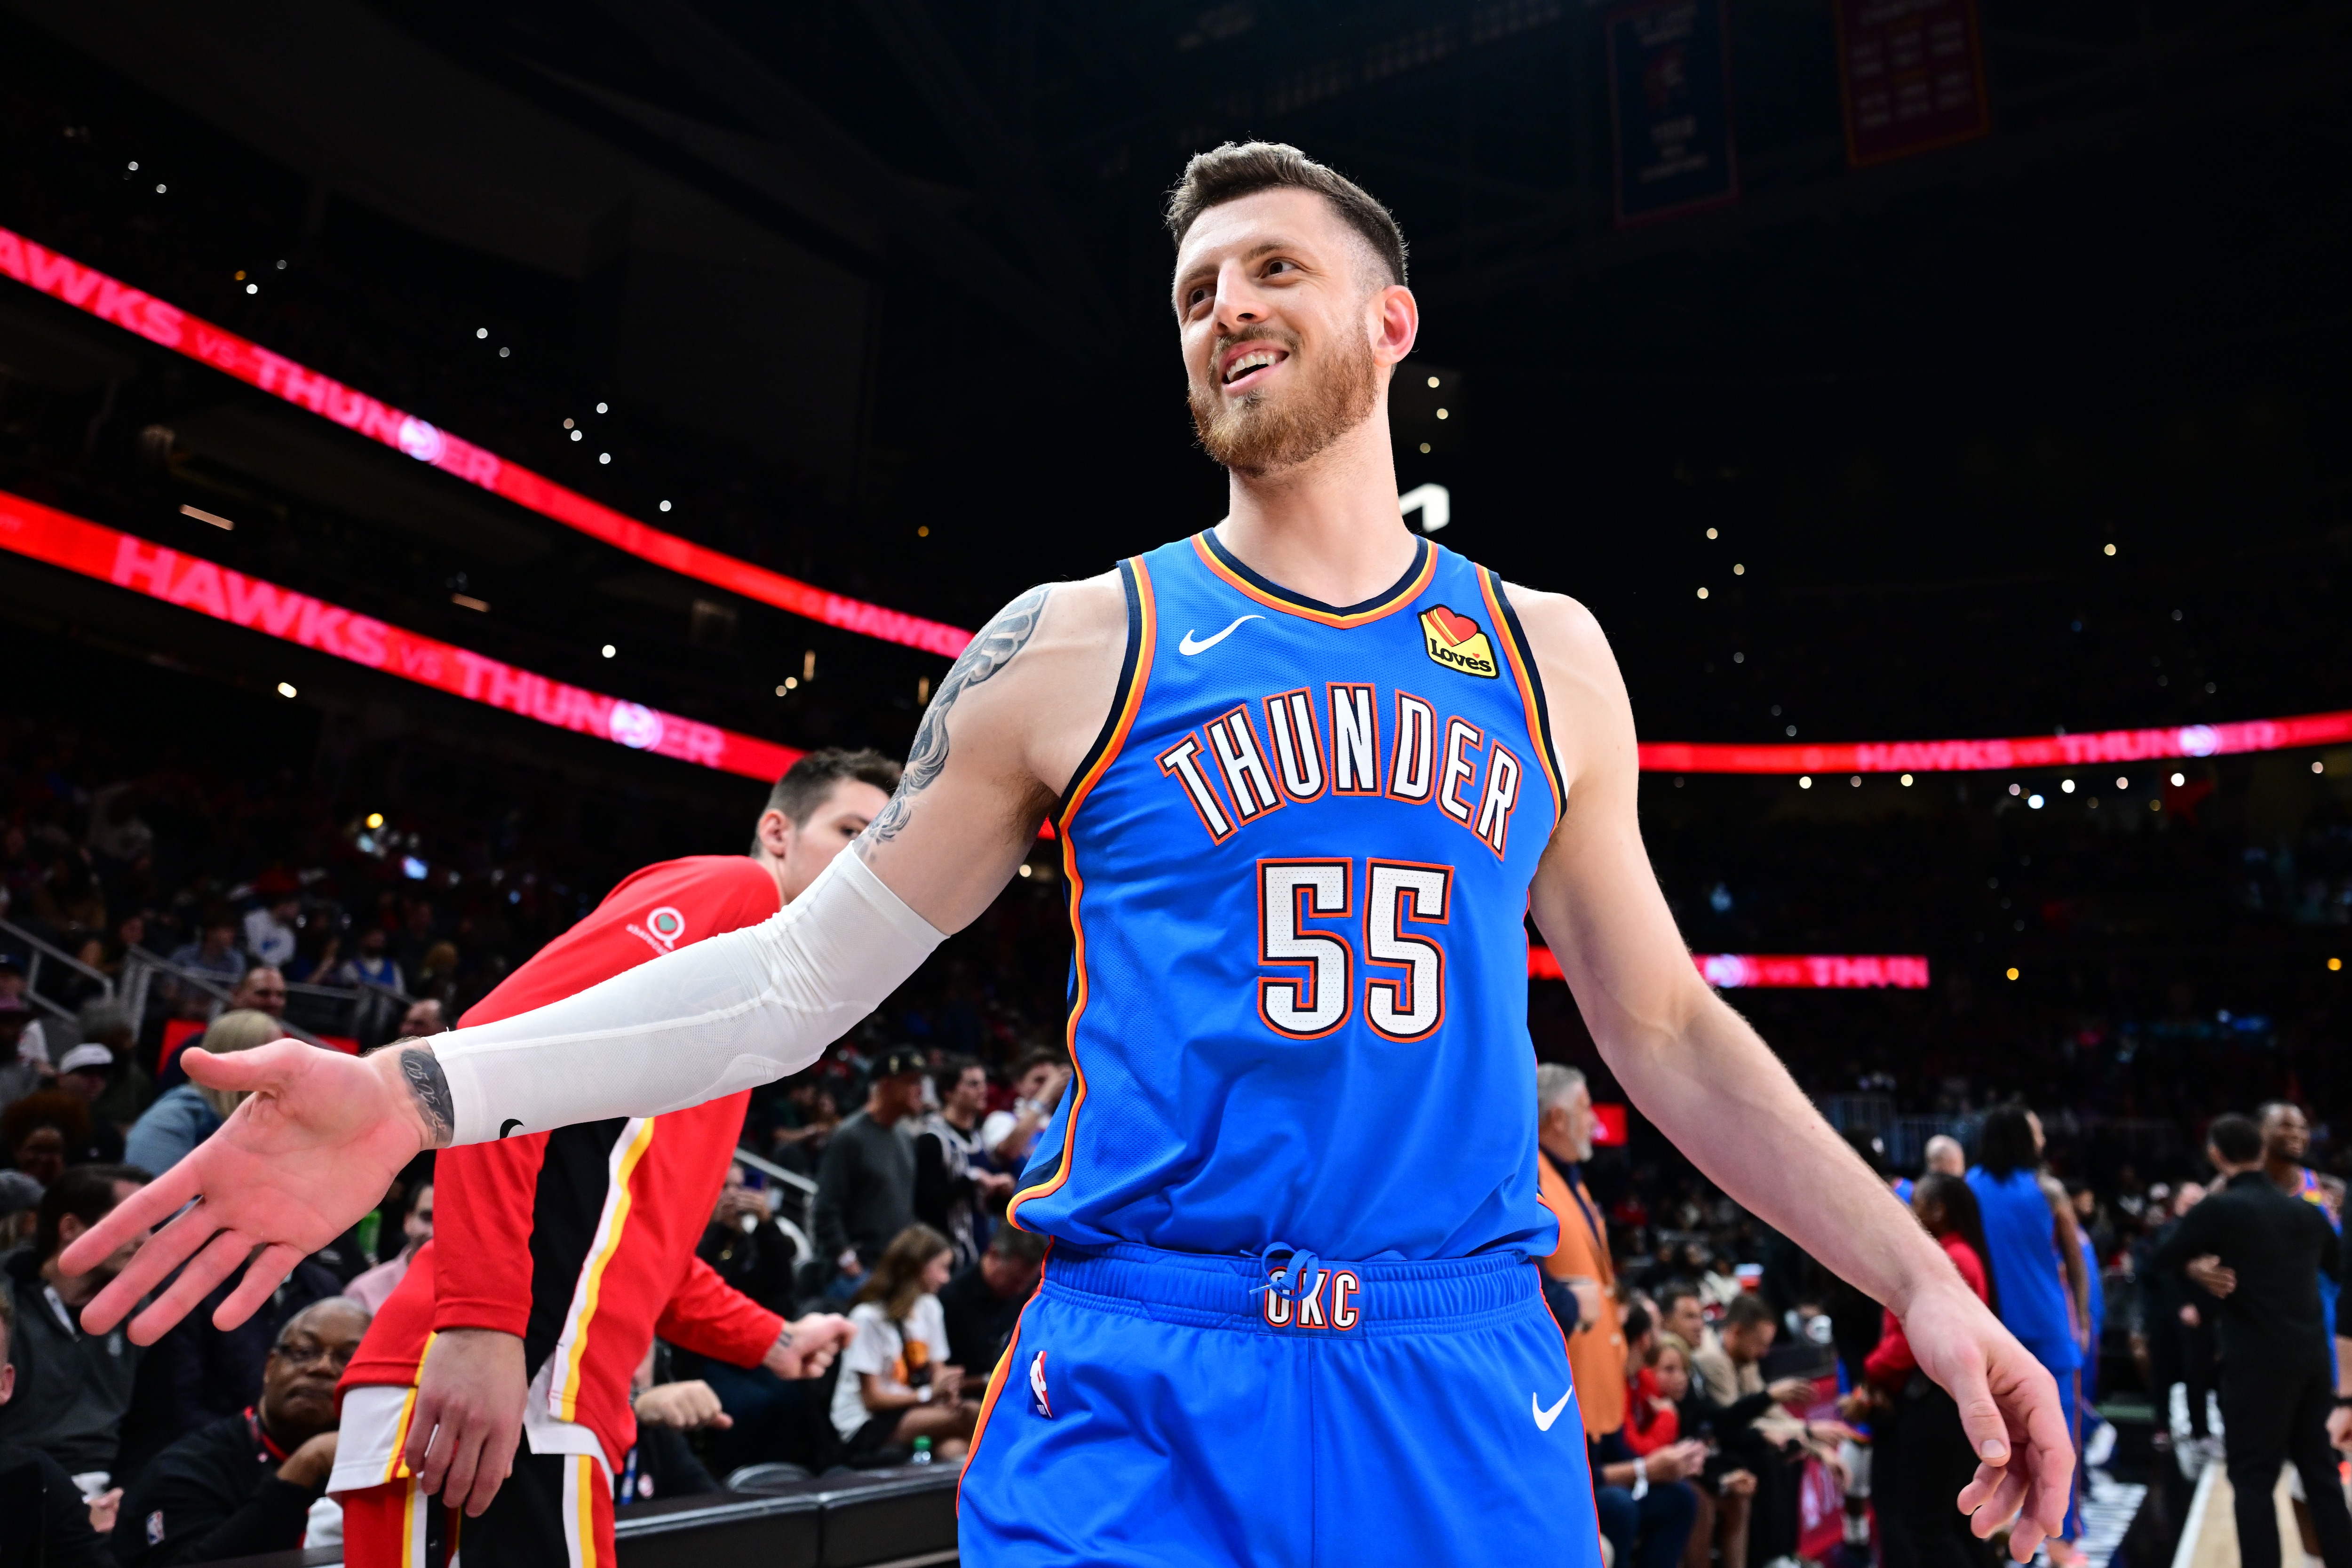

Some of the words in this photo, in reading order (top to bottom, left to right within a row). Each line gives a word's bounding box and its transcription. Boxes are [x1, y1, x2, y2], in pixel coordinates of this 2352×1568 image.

[250, 346, 501, 489] THUNER
[111, 535, 389, 667] HAWKS
[454, 650, 725, 767] THUNER
[1154, 682, 1521, 861] THUNDER
[1256, 857, 1454, 1043] 55
